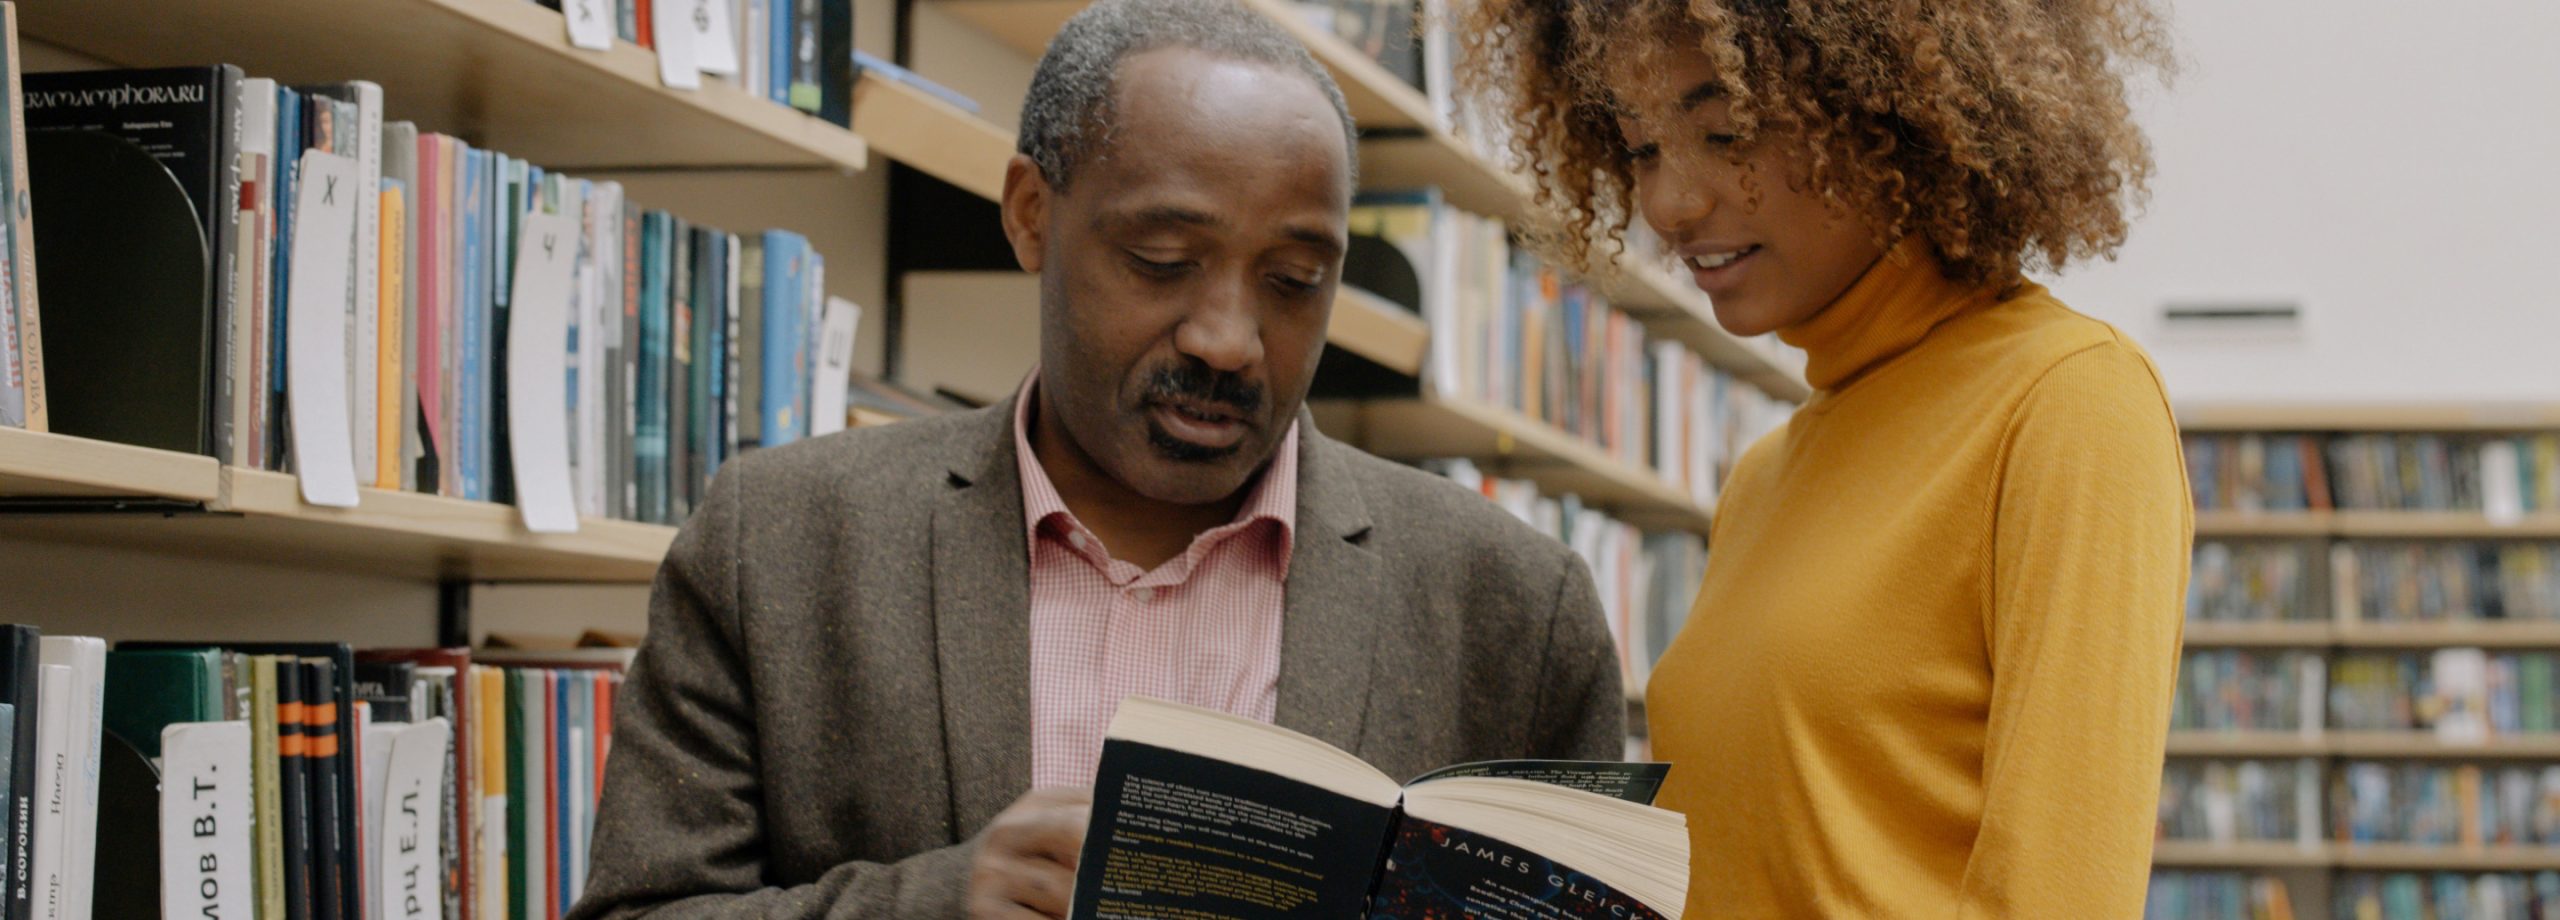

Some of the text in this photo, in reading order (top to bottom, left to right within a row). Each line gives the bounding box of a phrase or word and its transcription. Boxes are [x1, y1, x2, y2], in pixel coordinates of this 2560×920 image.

[26, 320, 42, 415] ГОЛОВА
[17, 796, 29, 881] СОРОКИН
[193, 765, 217, 838] В.Т.
[400, 778, 421, 854] Е.Л.
[1440, 837, 1530, 873] JAMES
